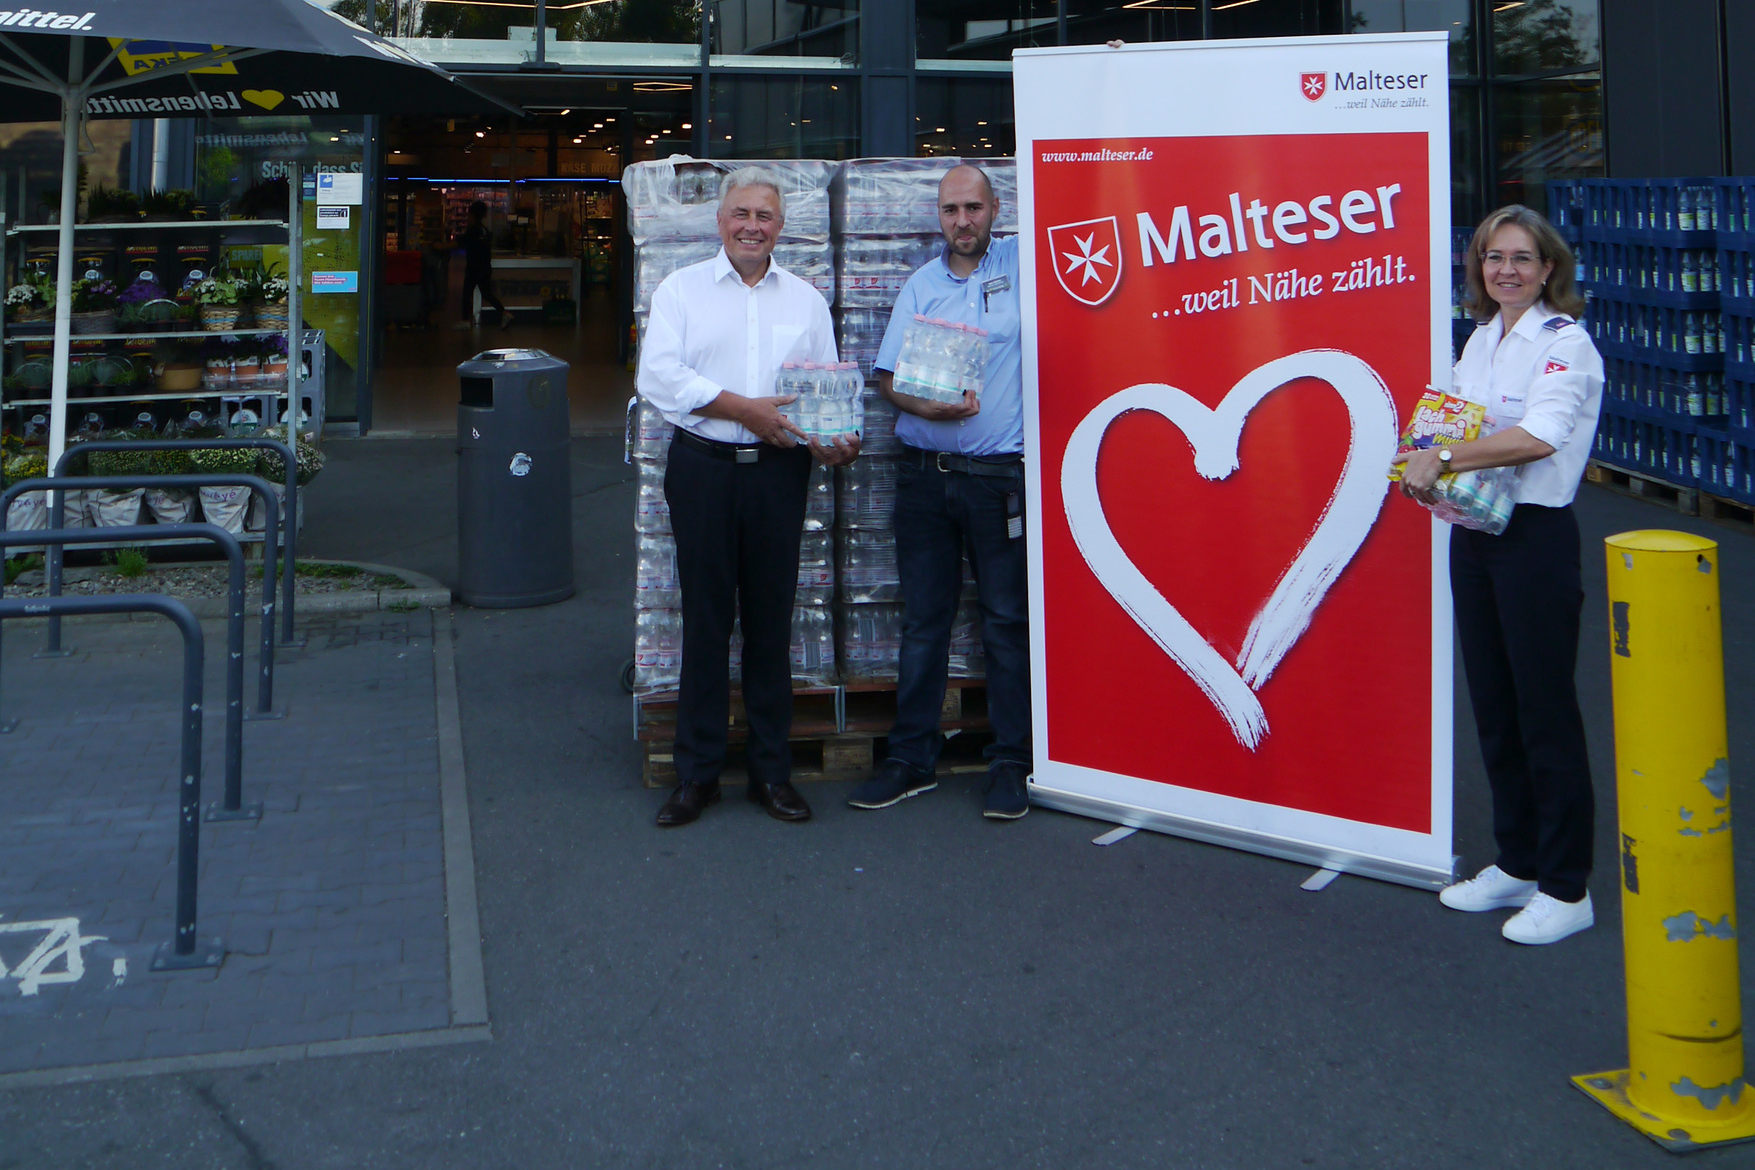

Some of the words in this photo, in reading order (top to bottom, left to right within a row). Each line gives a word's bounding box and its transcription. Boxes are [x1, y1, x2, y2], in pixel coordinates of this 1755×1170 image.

[1334, 70, 1428, 91] Malteser
[1370, 97, 1398, 109] Nähe
[1399, 96, 1429, 109] zählt.
[1041, 147, 1154, 163] www.malteser.de
[1136, 183, 1401, 268] Malteser
[1248, 267, 1323, 305] Nähe
[1332, 254, 1416, 294] zählt.
[1414, 405, 1446, 424] lach
[1411, 419, 1467, 440] gummi
